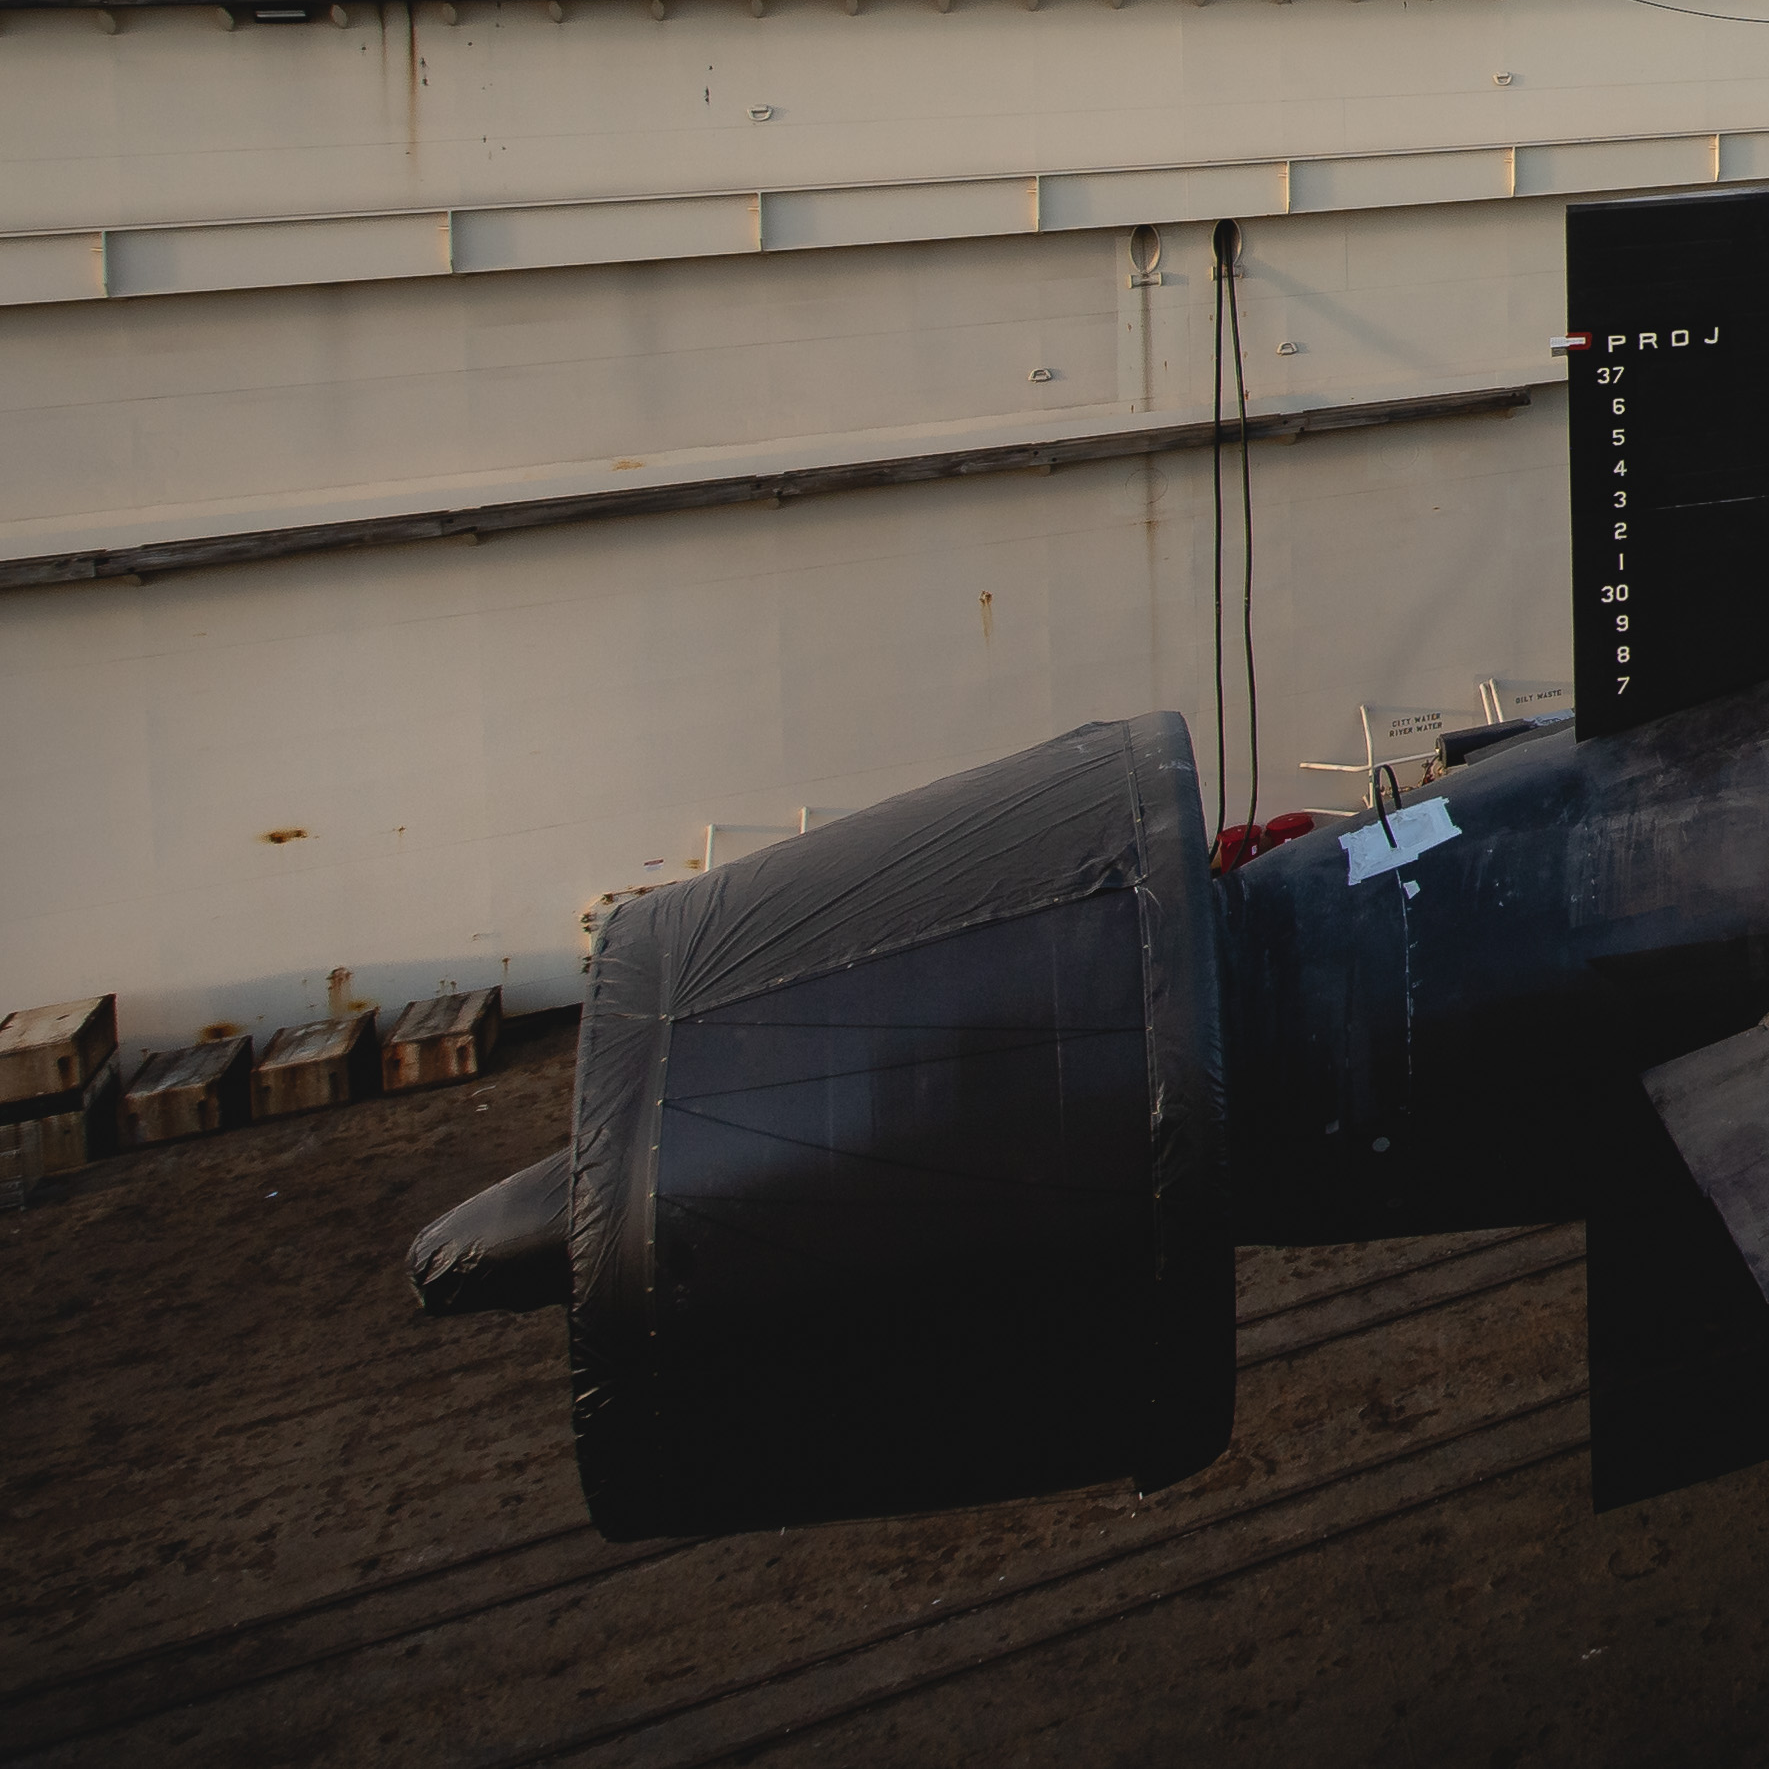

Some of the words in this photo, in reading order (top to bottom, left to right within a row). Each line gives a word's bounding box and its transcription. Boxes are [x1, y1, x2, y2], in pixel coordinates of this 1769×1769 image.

[1607, 326, 1720, 353] PROJ
[1596, 366, 1625, 385] 37
[1612, 397, 1626, 415] 6
[1612, 428, 1625, 446] 5
[1613, 459, 1628, 477] 4
[1613, 491, 1627, 509] 3
[1614, 522, 1628, 541] 2
[1600, 583, 1629, 603] 30
[1616, 614, 1629, 632] 9
[1616, 645, 1631, 664] 8
[1616, 676, 1630, 695] 7
[1515, 694, 1533, 704] OILY
[1537, 689, 1562, 701] WASTE
[1392, 717, 1411, 728] CITY
[1414, 712, 1441, 724] WATER
[1389, 726, 1413, 738] RIVER
[1417, 721, 1442, 732] WATER
